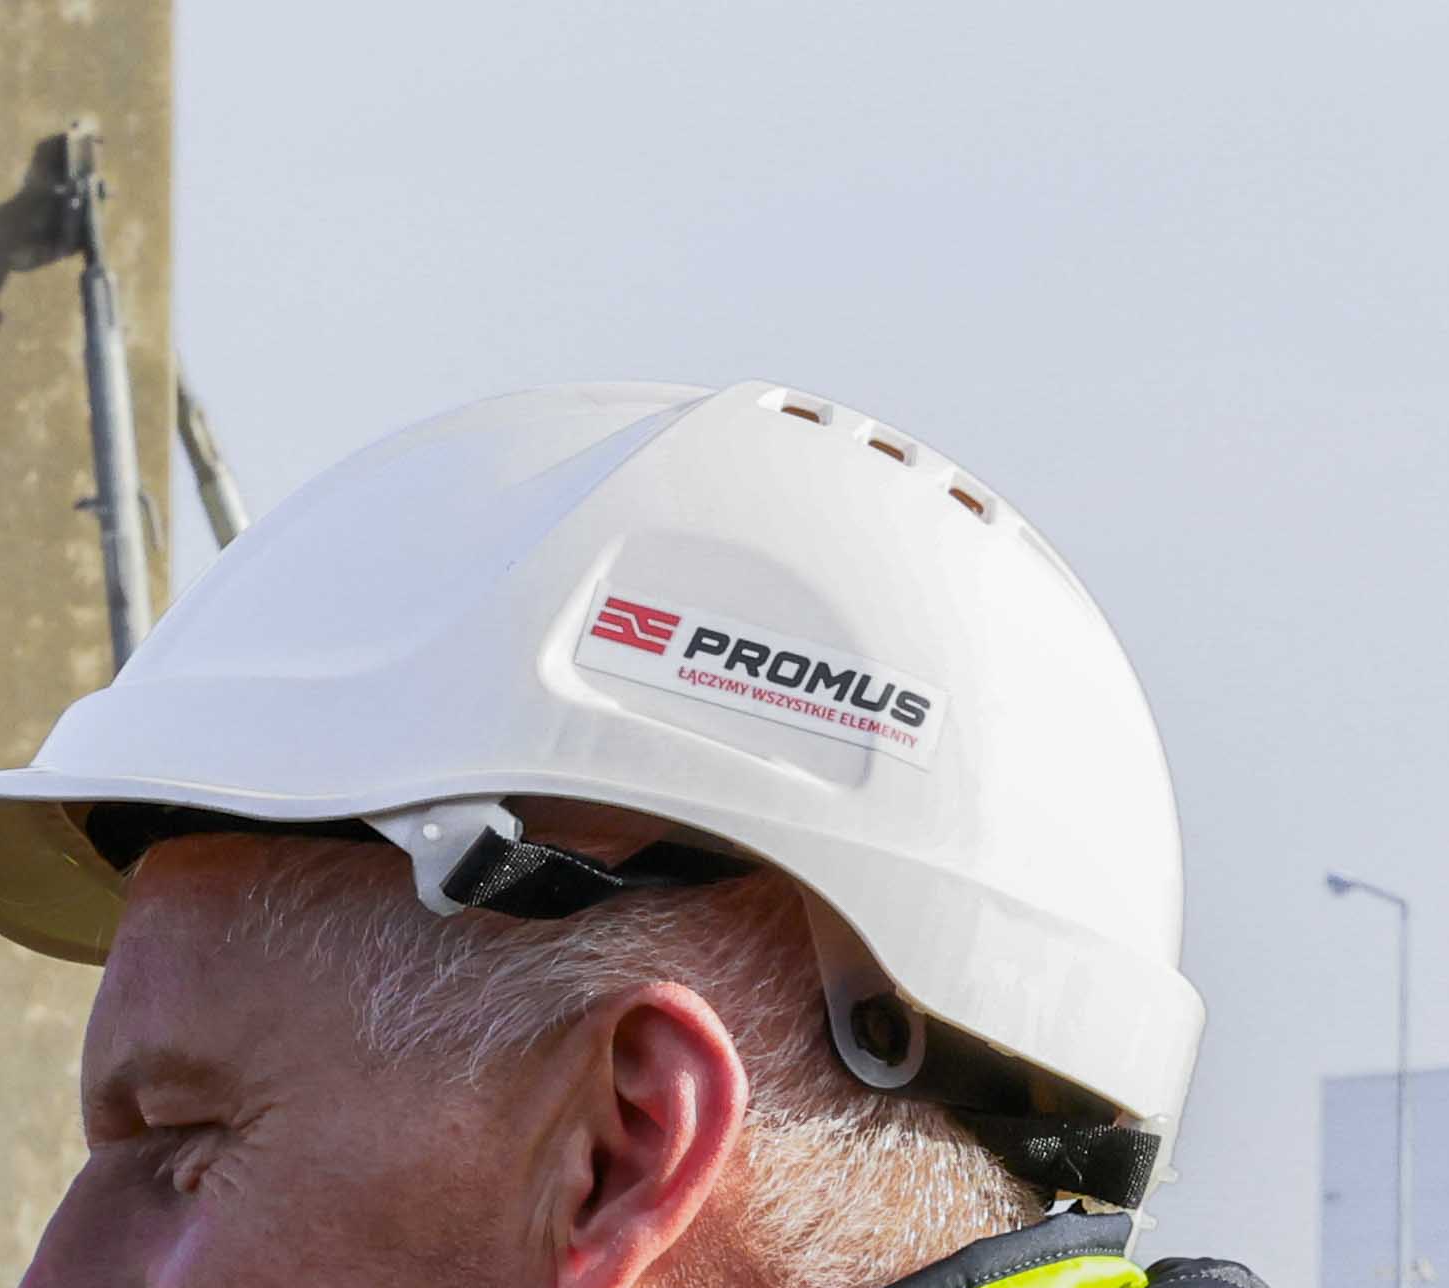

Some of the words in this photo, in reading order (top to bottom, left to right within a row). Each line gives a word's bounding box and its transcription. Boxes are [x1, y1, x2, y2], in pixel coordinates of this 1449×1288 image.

[677, 665, 750, 695] ŁĄCZYMY
[751, 685, 835, 722] WSZYSTKIE
[839, 711, 919, 749] ELEMENTY
[683, 626, 932, 728] PROMUS
